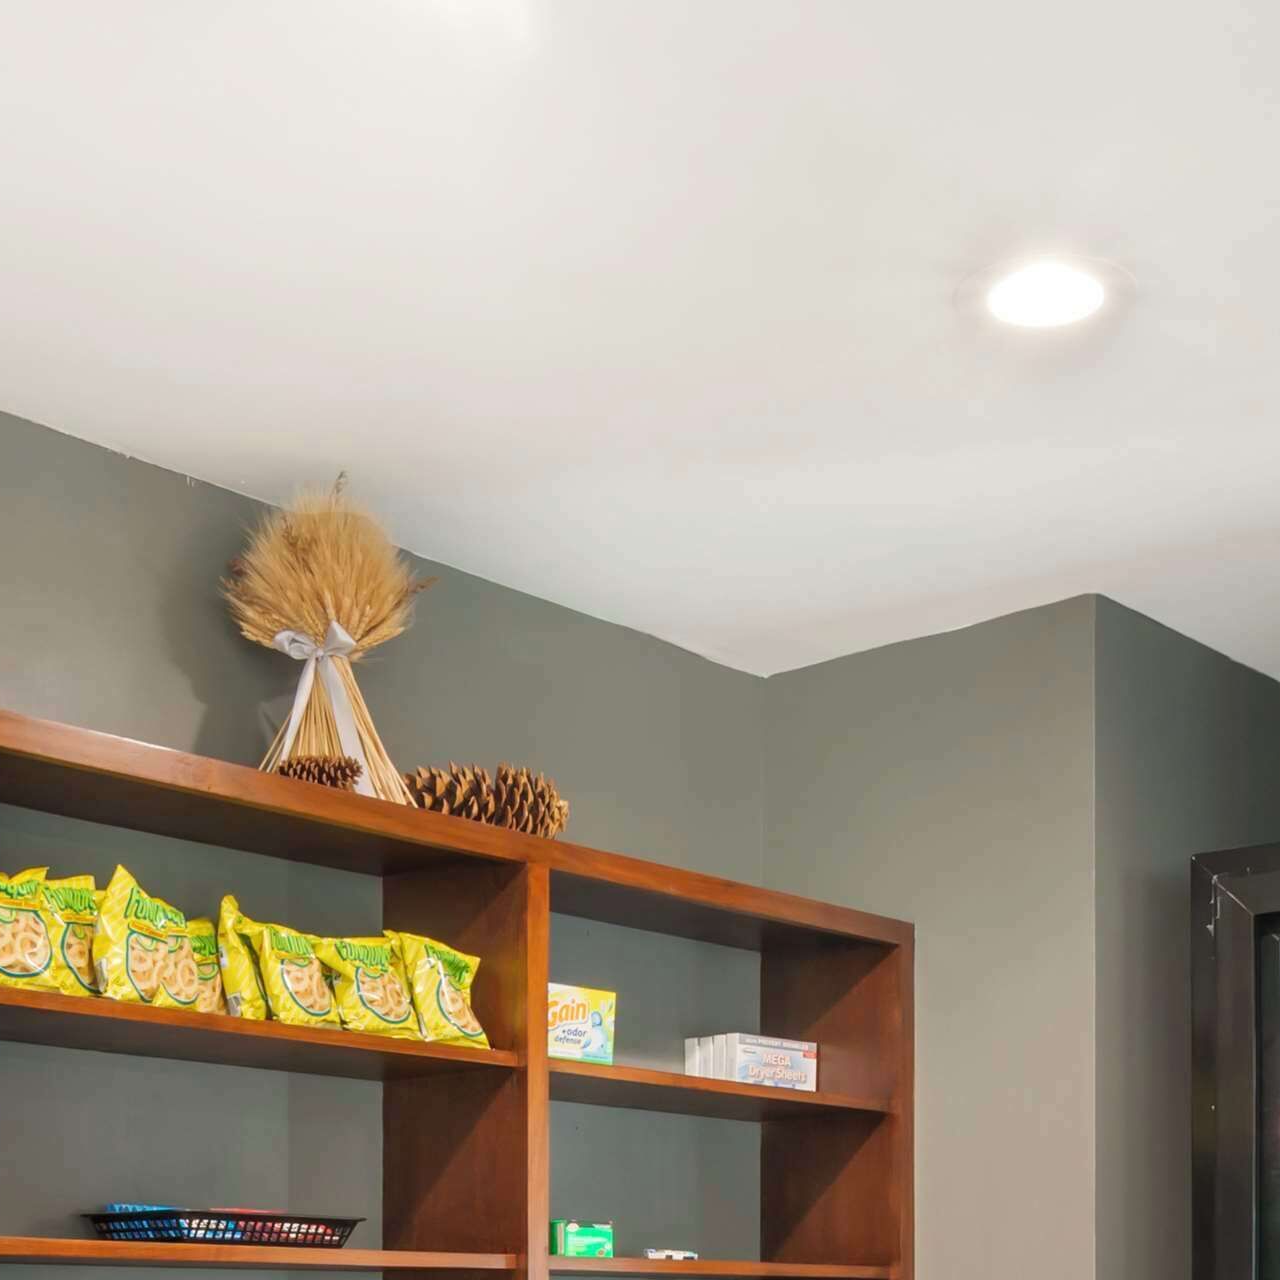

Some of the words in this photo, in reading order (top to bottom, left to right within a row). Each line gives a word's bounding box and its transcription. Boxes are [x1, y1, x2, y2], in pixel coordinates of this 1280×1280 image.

[547, 999, 588, 1028] Gain
[762, 1053, 792, 1067] MEGA
[774, 1067, 808, 1084] Sheets
